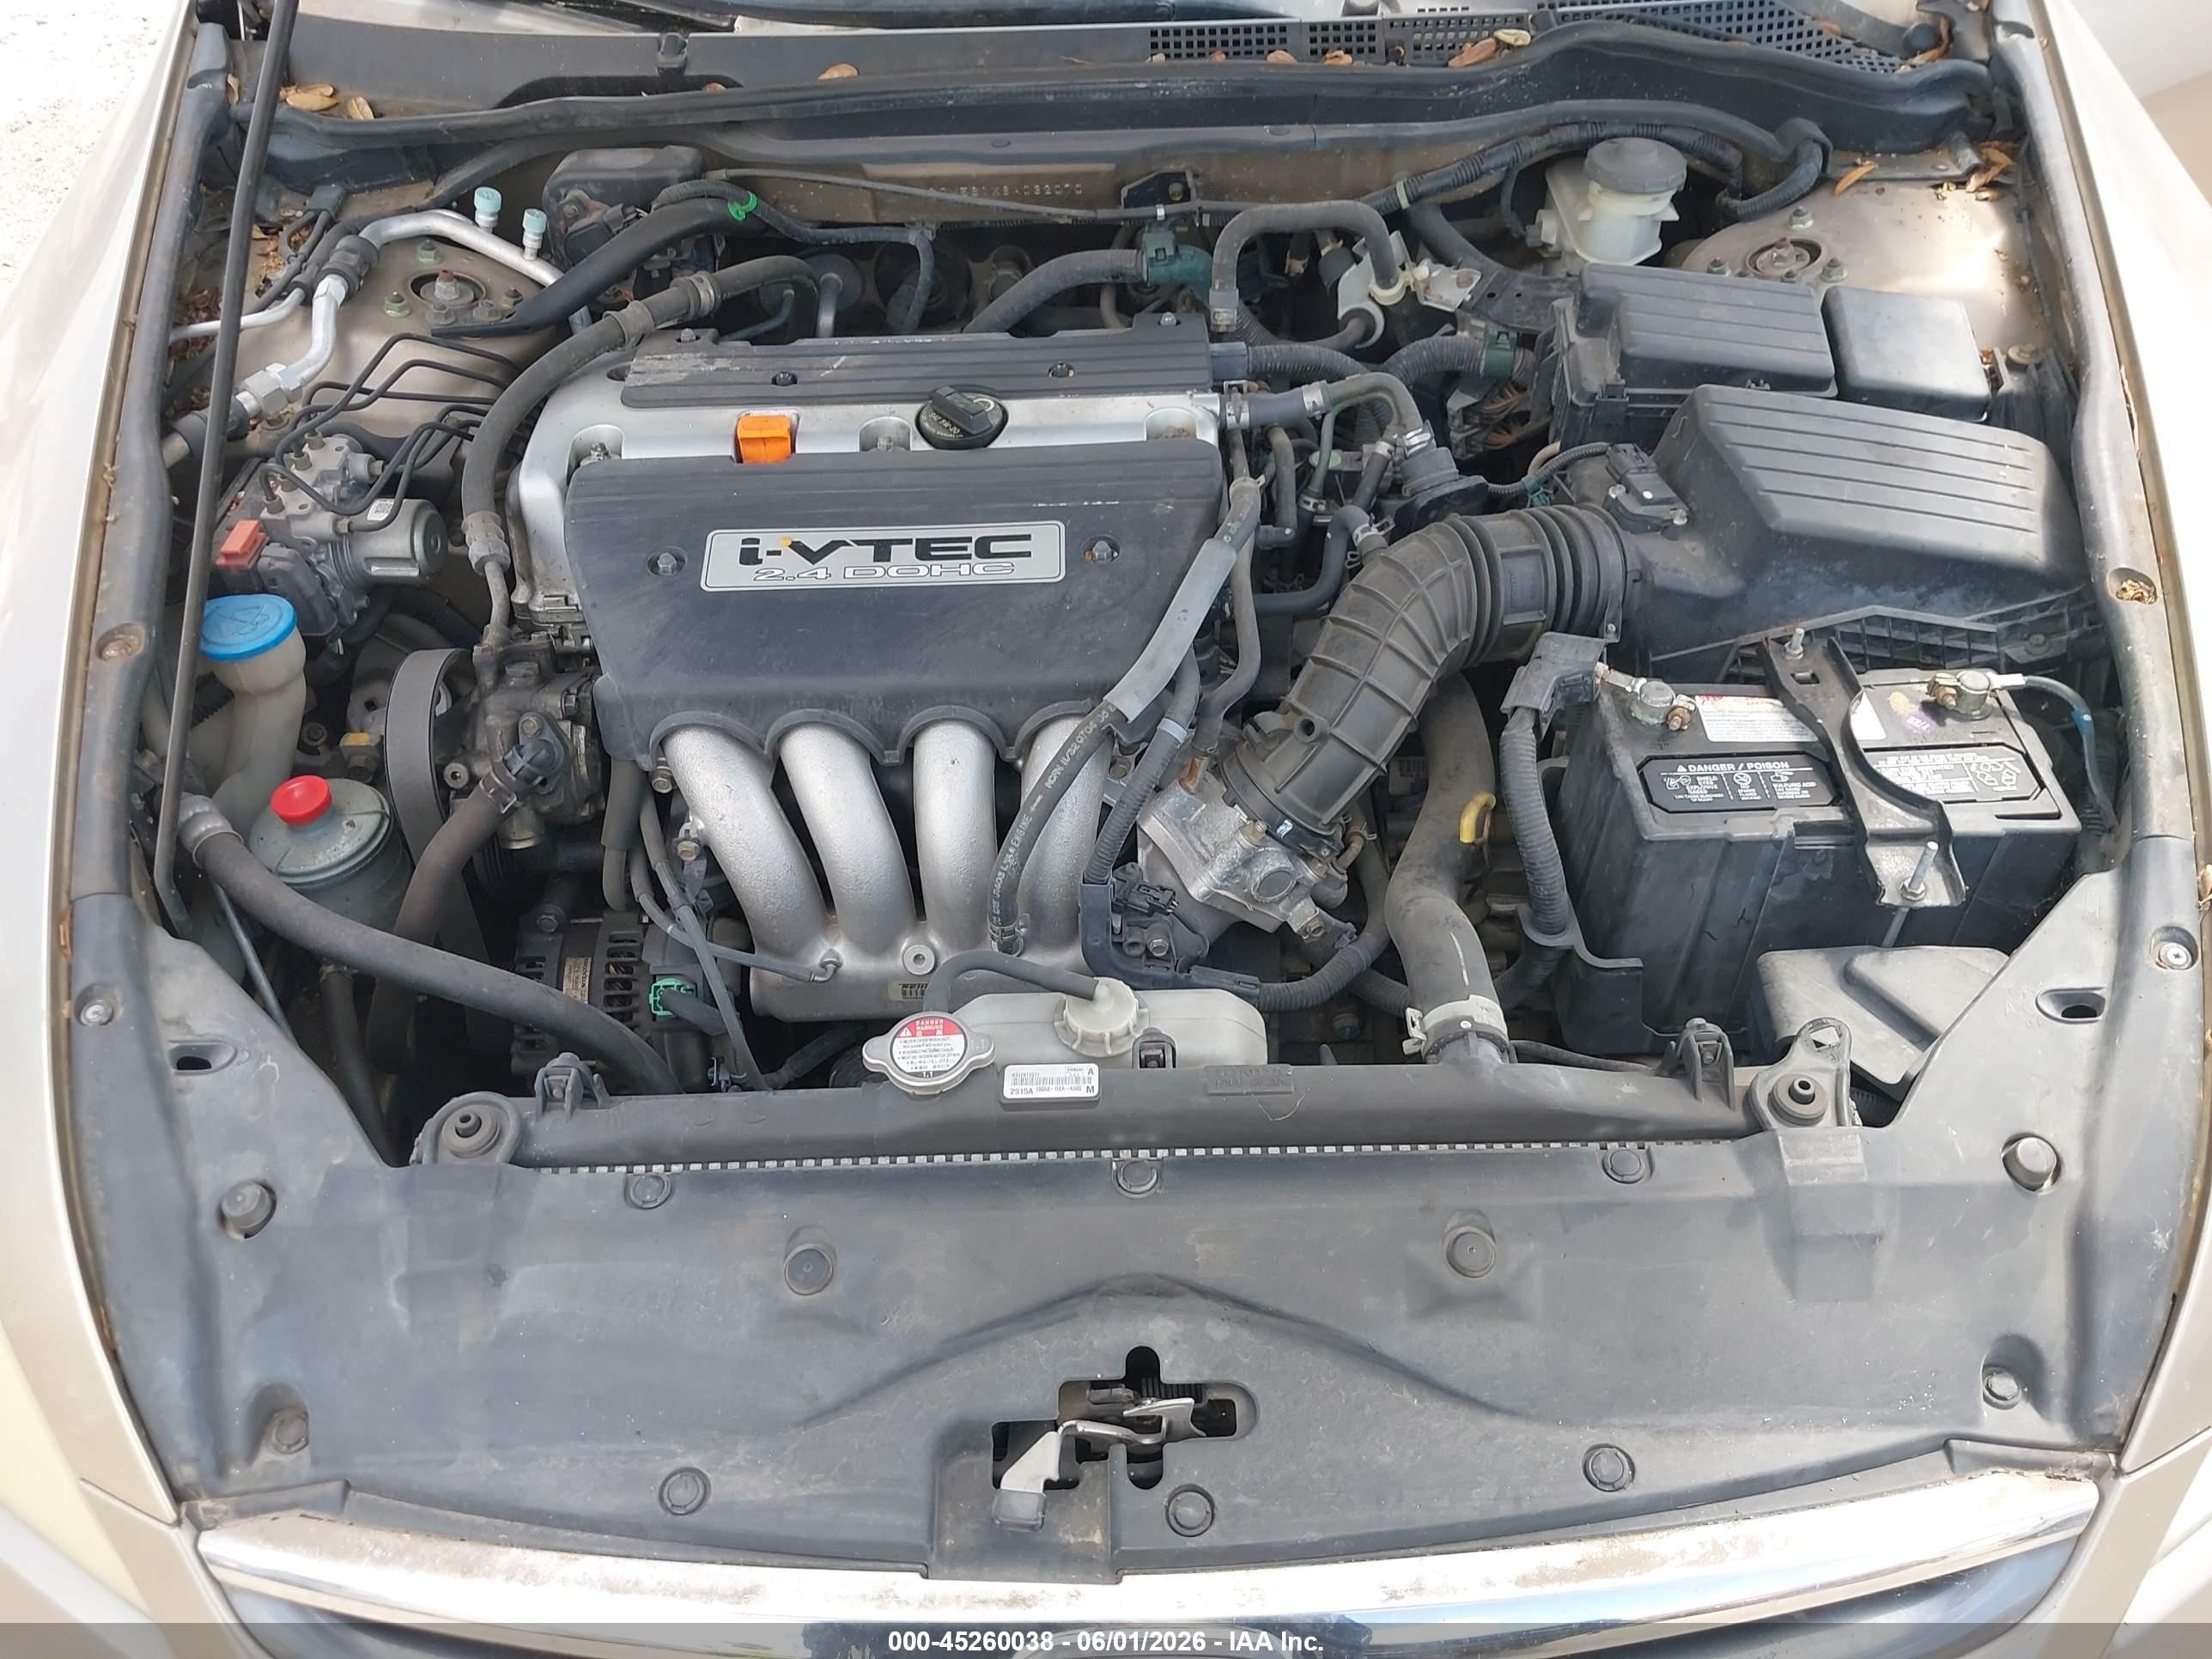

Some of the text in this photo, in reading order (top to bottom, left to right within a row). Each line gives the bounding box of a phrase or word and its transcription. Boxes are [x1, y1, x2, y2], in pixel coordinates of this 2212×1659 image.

[738, 534, 1032, 566] i-VTEC
[754, 562, 1015, 581] 2.4 DOHC
[1687, 763, 1735, 772] DANGER
[1747, 761, 1790, 769] POISON
[1087, 1067, 1094, 1076] A
[1086, 1085, 1095, 1094] M
